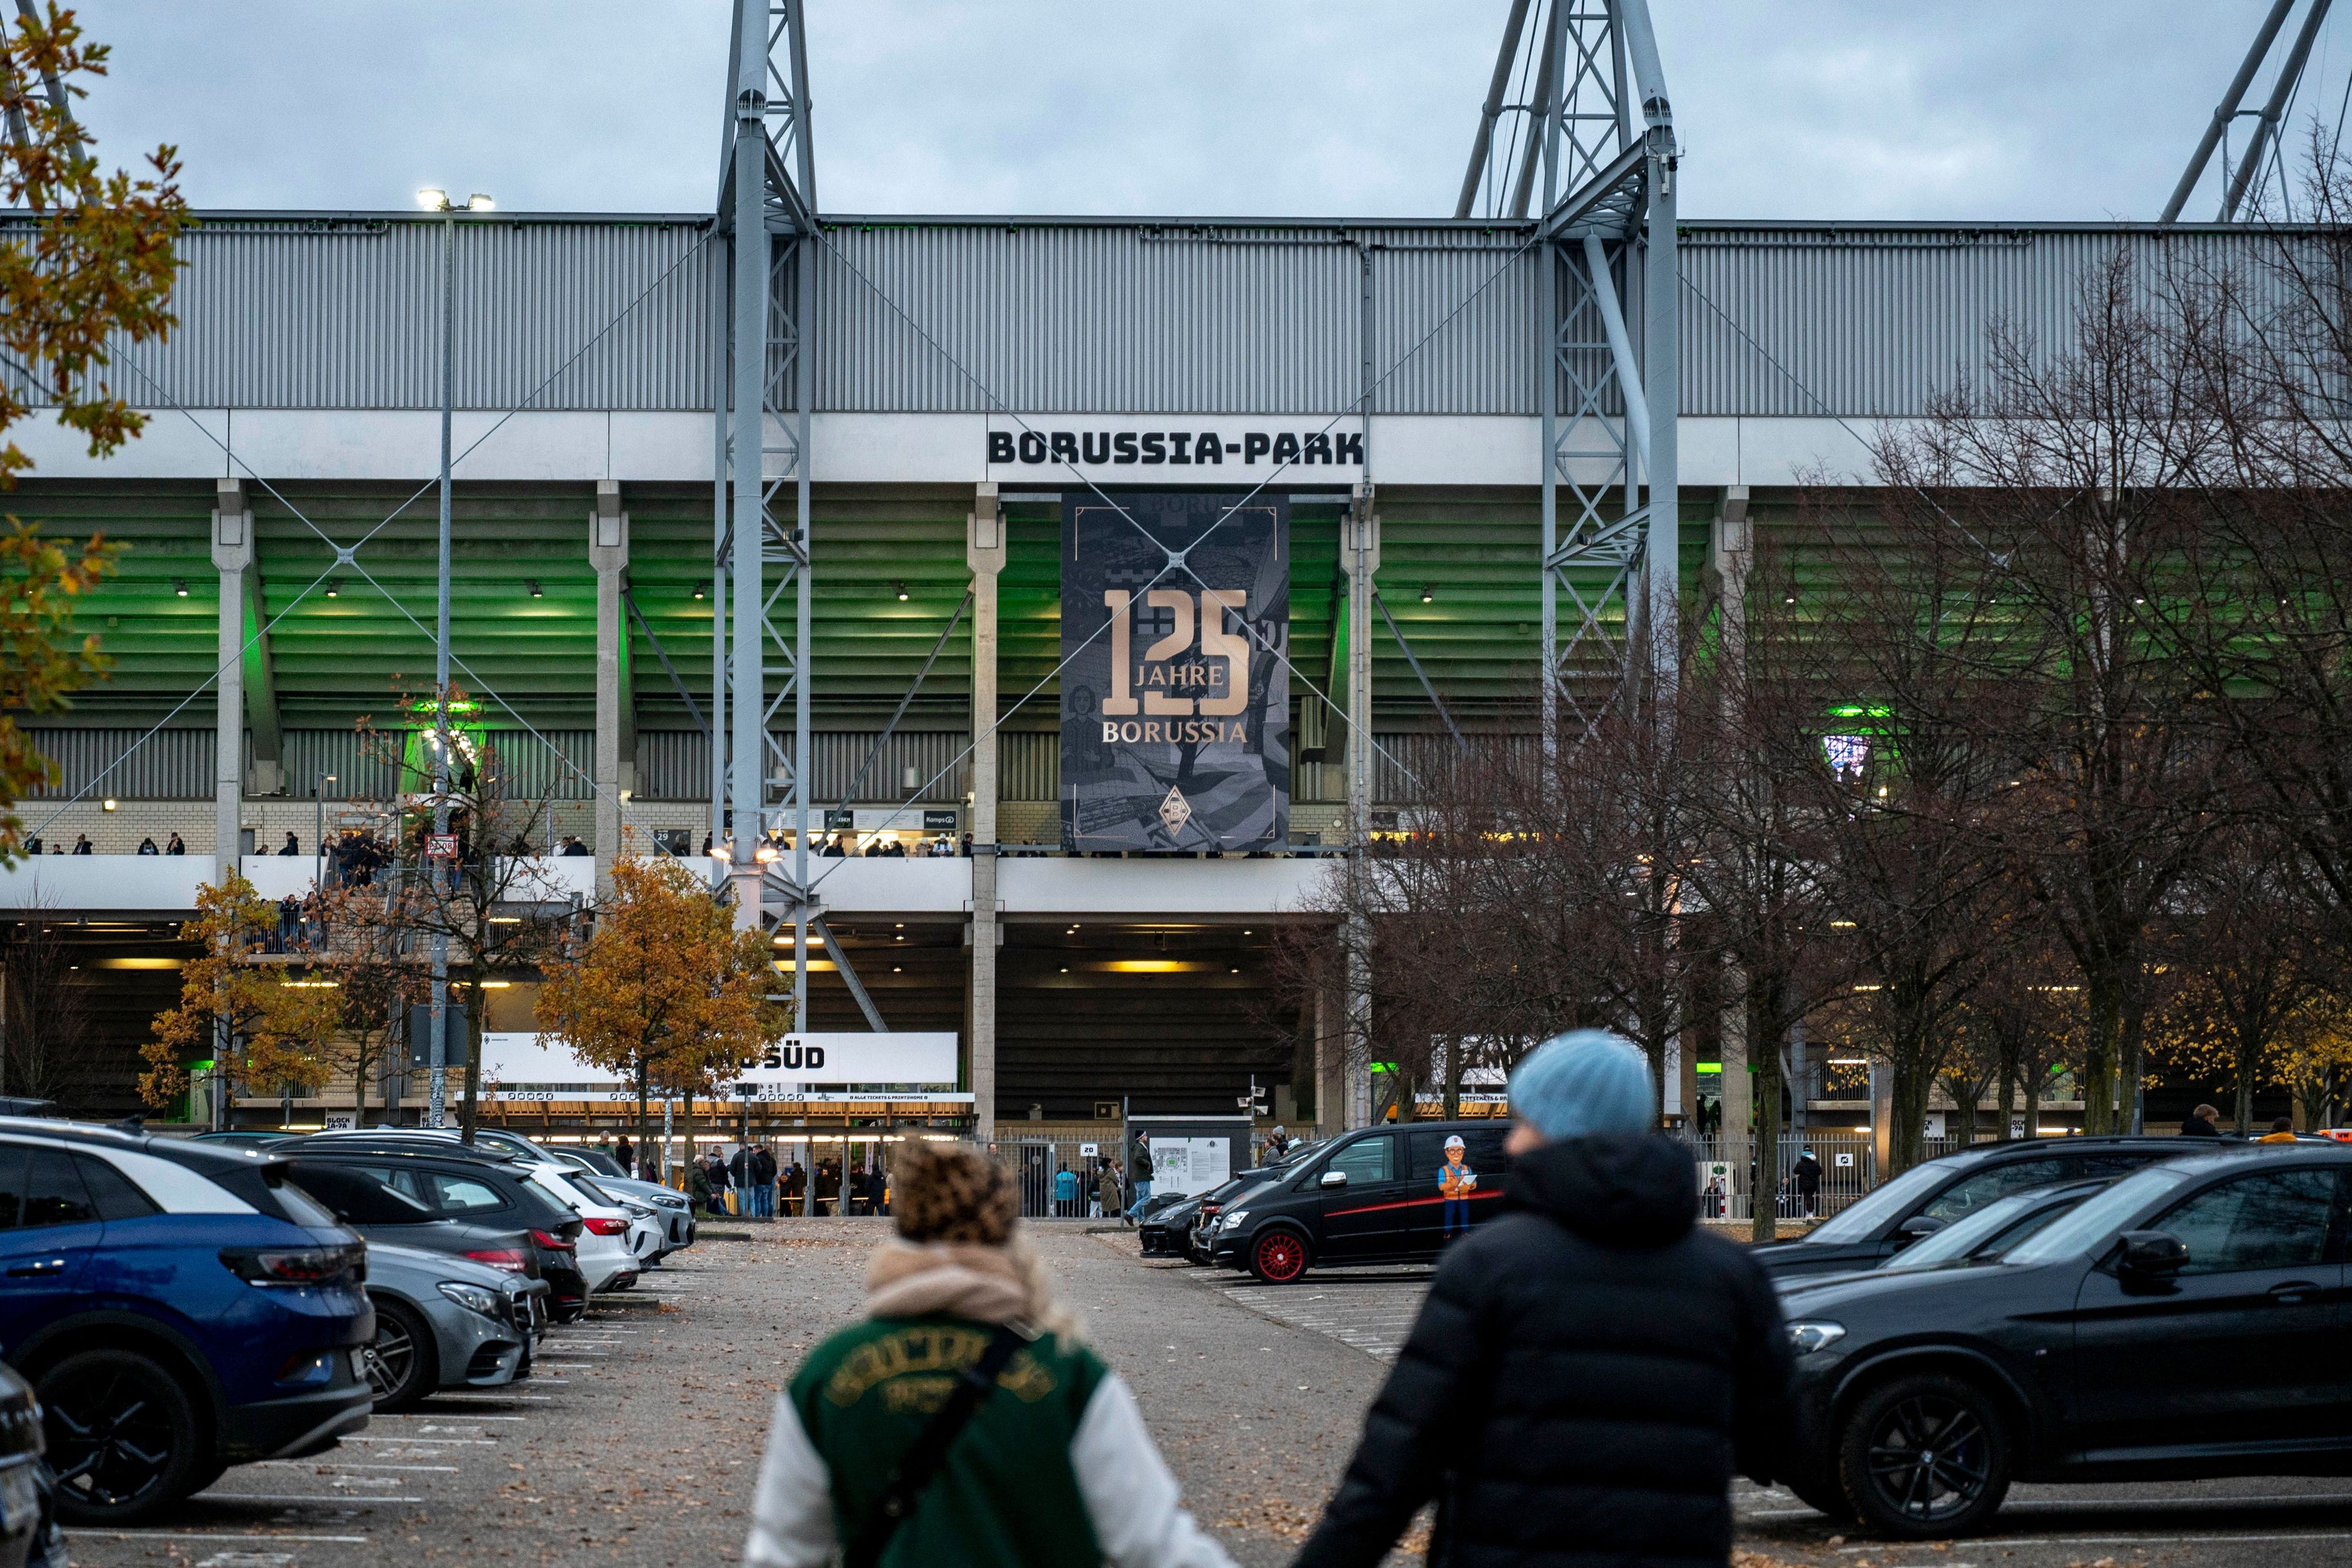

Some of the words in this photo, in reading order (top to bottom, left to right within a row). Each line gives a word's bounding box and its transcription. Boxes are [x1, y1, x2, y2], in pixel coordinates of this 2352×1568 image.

[988, 432, 1363, 464] BORUSSIA-PARK
[1102, 590, 1249, 716] 125
[1134, 665, 1222, 686] JAHRE
[1102, 721, 1248, 743] BORUSSIA
[657, 833, 669, 841] 29
[764, 1040, 824, 1069] SÜD
